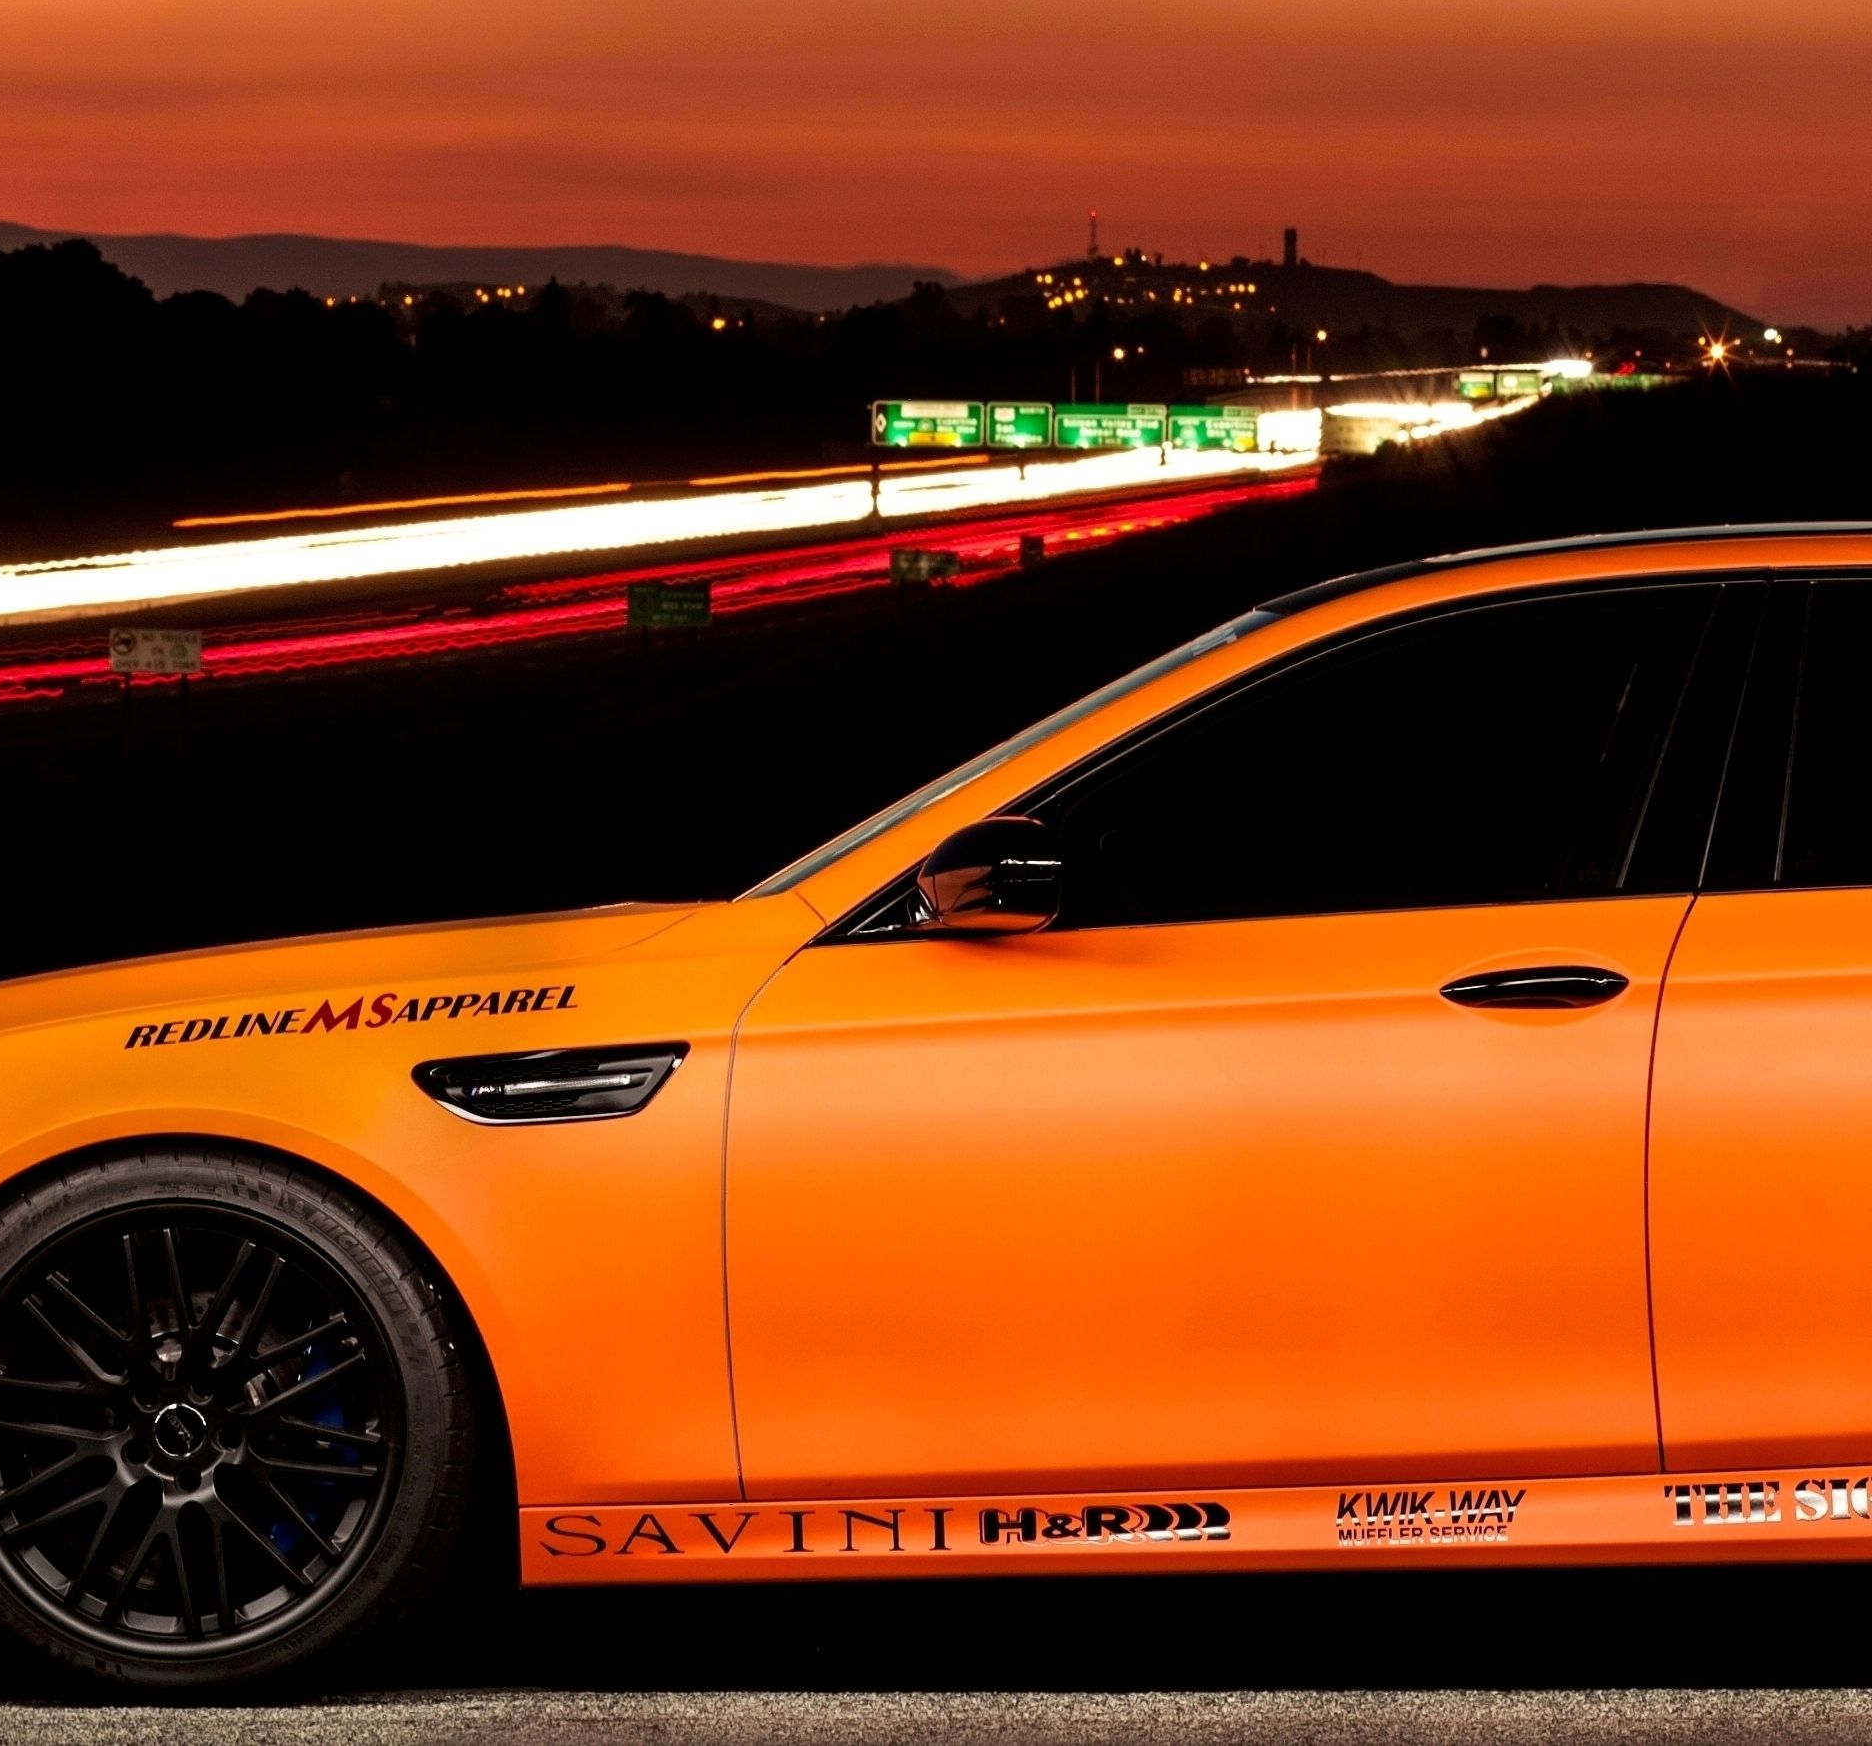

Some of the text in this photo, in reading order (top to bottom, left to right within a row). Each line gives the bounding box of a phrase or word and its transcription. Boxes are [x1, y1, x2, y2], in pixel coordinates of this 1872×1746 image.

[309, 1210, 408, 1315] MICHELIN
[1336, 1489, 1527, 1526] KWIK-WAY
[1664, 1480, 1782, 1526] THE
[539, 1505, 1138, 1557] SAVINI H&R
[1338, 1525, 1509, 1547] MUFFLER SERVICE
